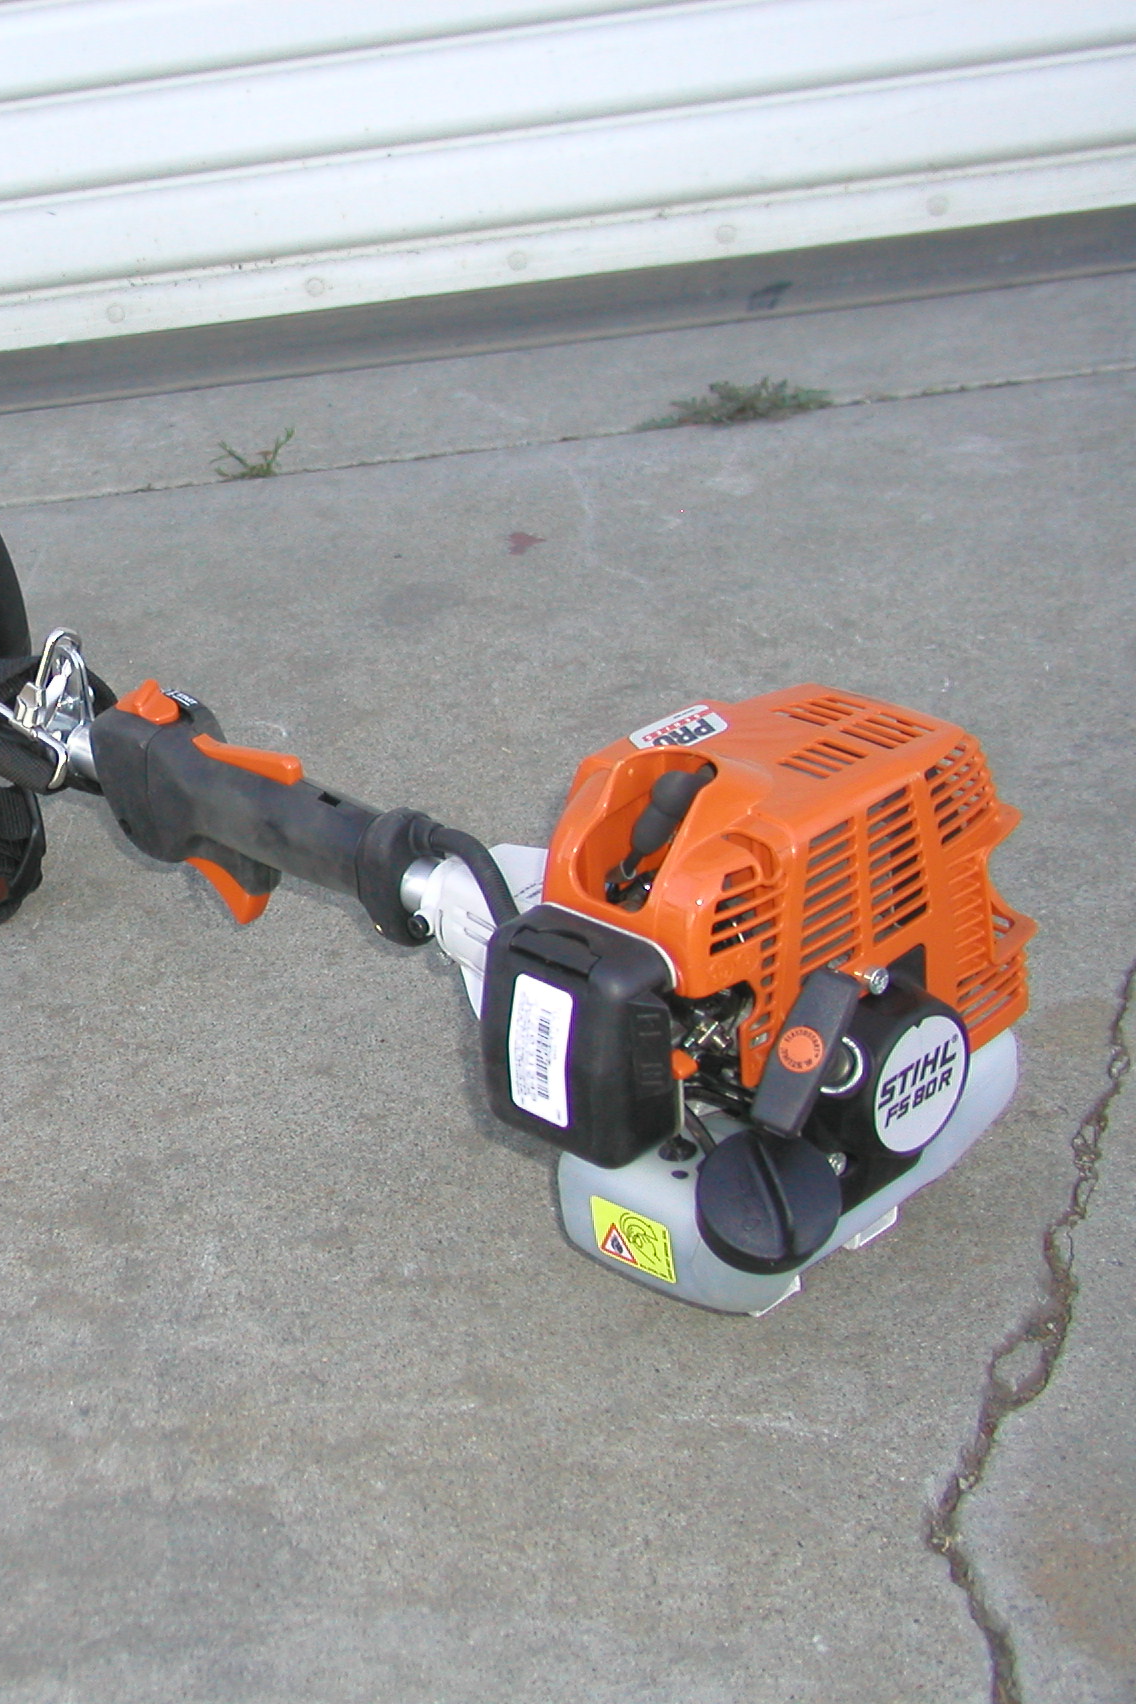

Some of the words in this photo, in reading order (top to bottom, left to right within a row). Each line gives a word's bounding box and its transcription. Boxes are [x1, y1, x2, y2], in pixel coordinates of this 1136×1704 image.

[652, 717, 716, 746] PRO
[877, 1039, 957, 1111] STIHL
[884, 1094, 911, 1129] FS
[912, 1066, 953, 1109] 80R
